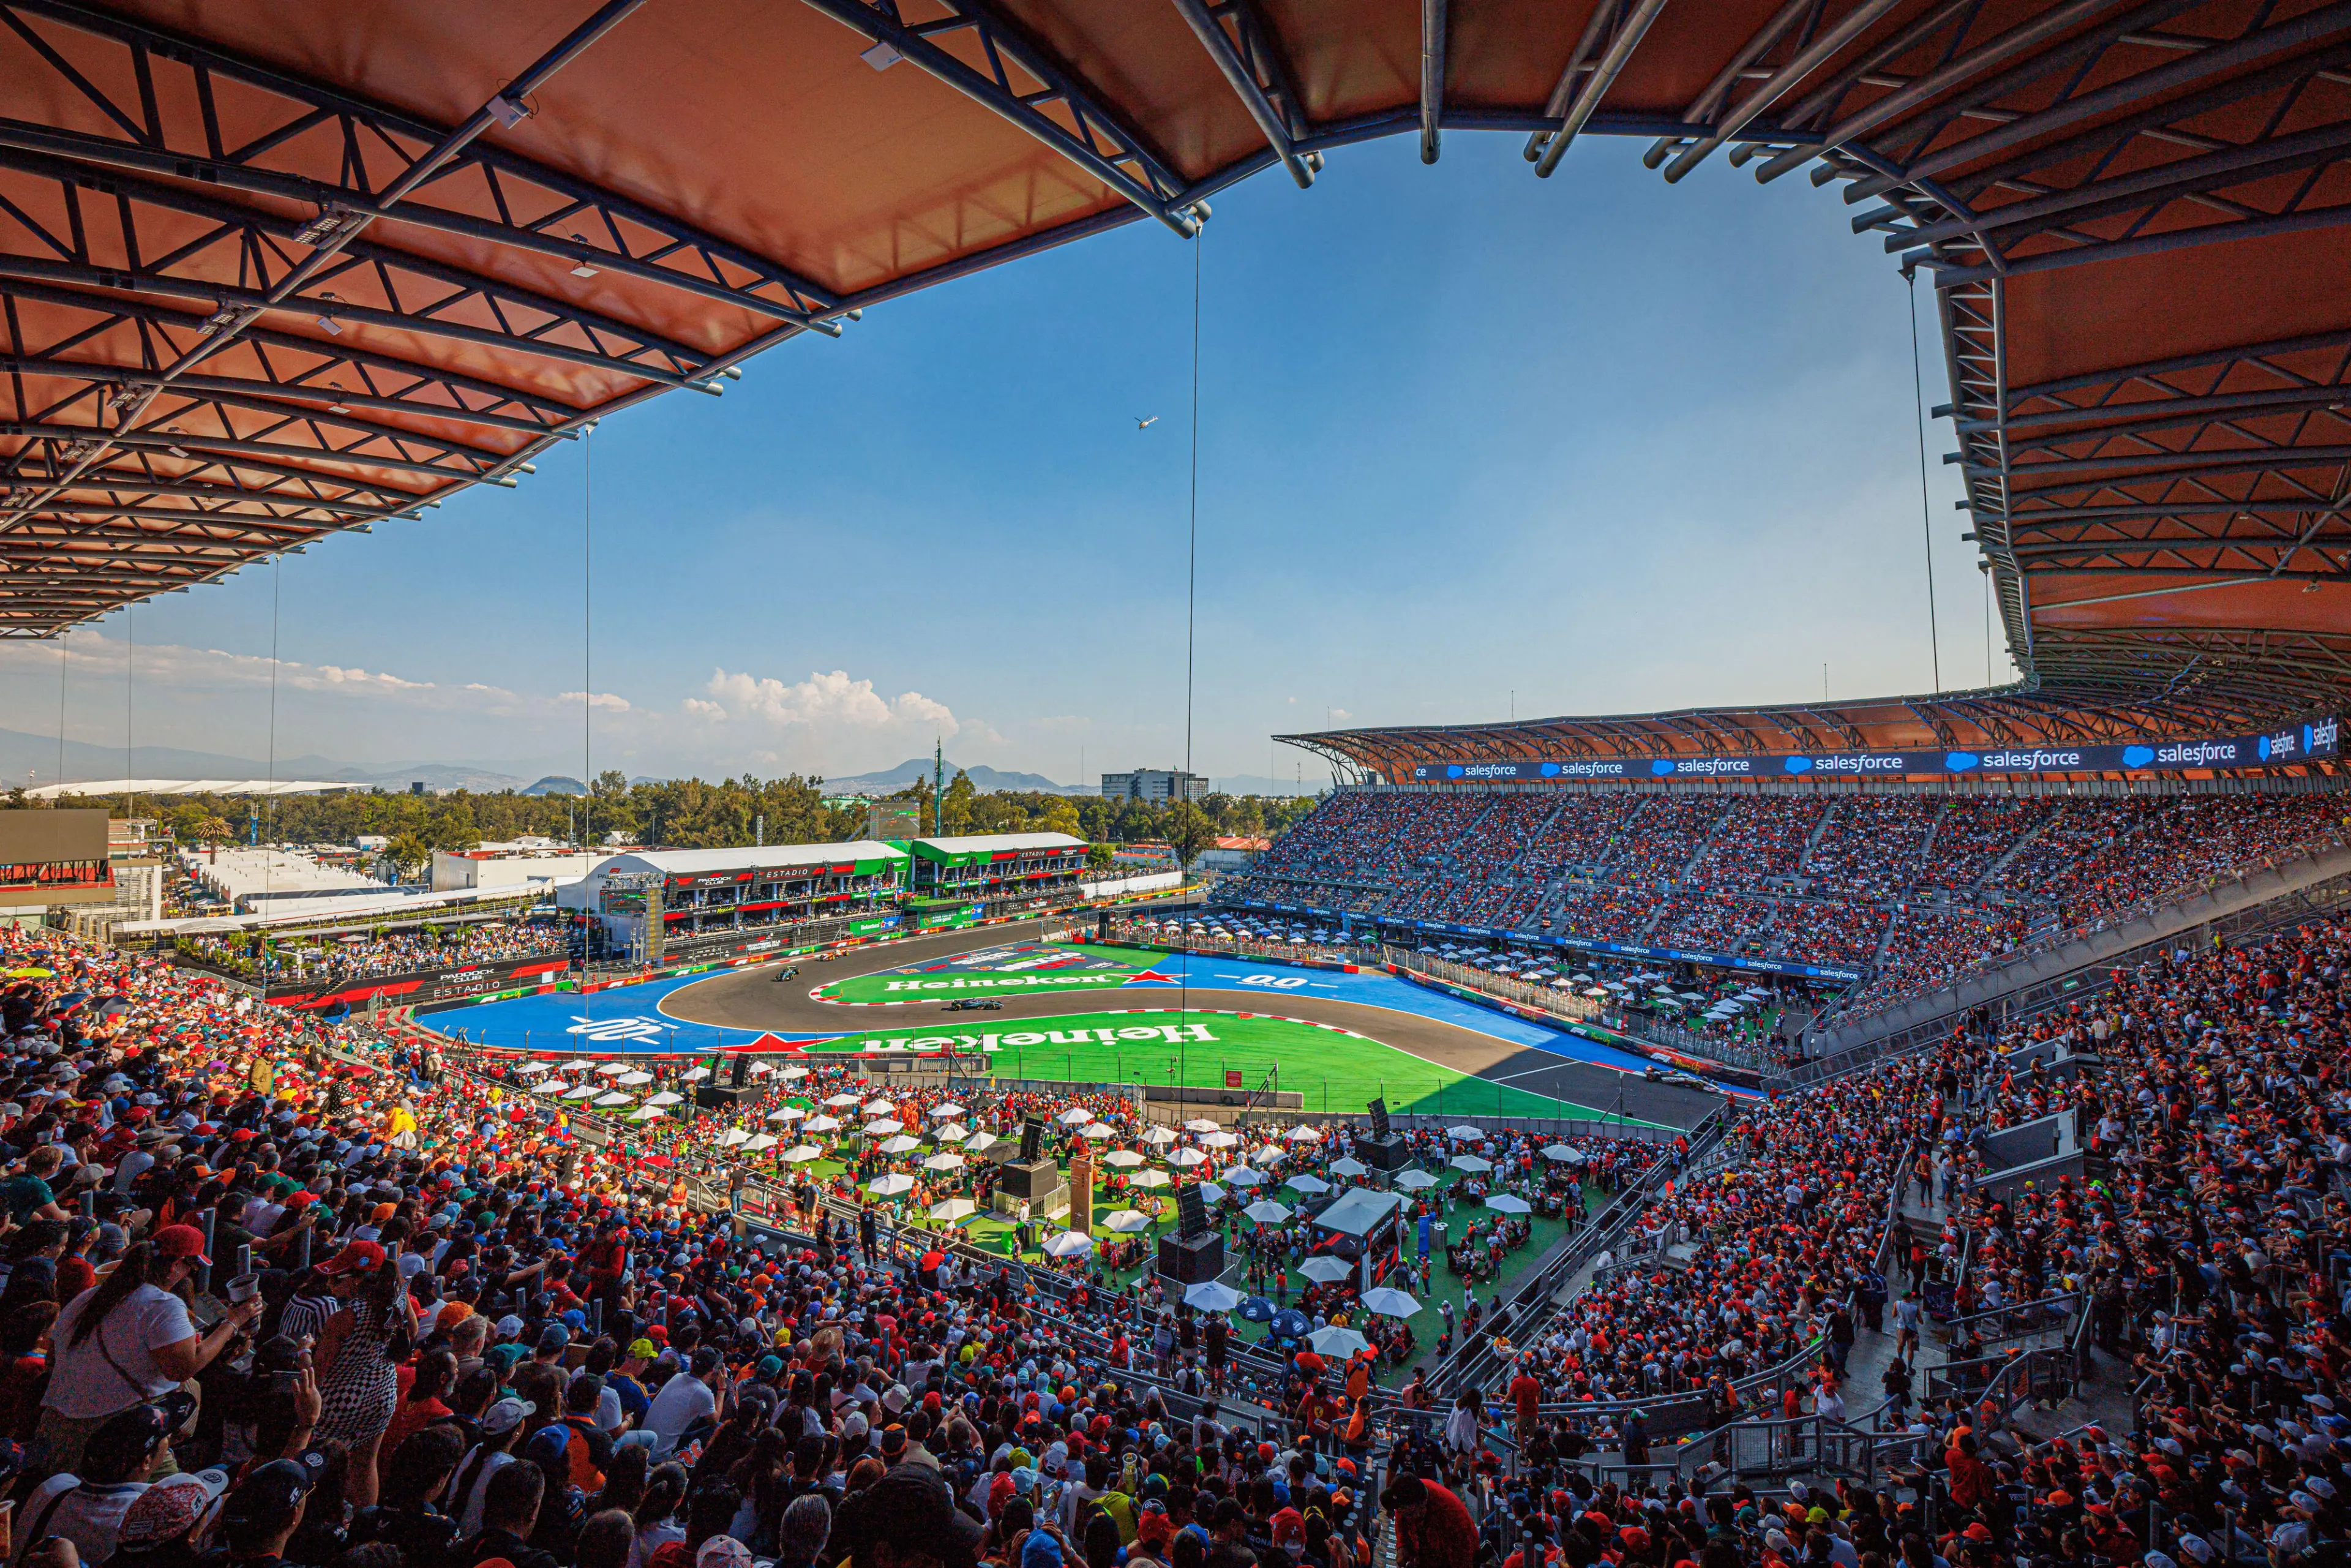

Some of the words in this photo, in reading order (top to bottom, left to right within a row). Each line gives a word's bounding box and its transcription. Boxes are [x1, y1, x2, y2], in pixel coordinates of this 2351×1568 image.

[2271, 731, 2295, 758] salesforce
[1983, 749, 2080, 770] salesforce
[2158, 742, 2235, 765] salesforce
[1465, 764, 1516, 778] salesforce
[1562, 762, 1622, 776] salesforce
[1678, 759, 1749, 775] salesforce
[1815, 755, 1903, 772] salesforce
[767, 869, 808, 878] ESTADIO
[1621, 945, 1650, 954] salesforce
[1681, 951, 1713, 962] salesforce
[995, 952, 1082, 972] MEXICO
[1747, 960, 1782, 970] salesforce
[440, 968, 495, 980] PADDOCK
[1820, 969, 1859, 980] salesforce
[433, 981, 500, 997] ESTADIO
[884, 975, 1112, 992] Heineken
[479, 995, 499, 1003] F1
[860, 1024, 1220, 1052] Heineken
